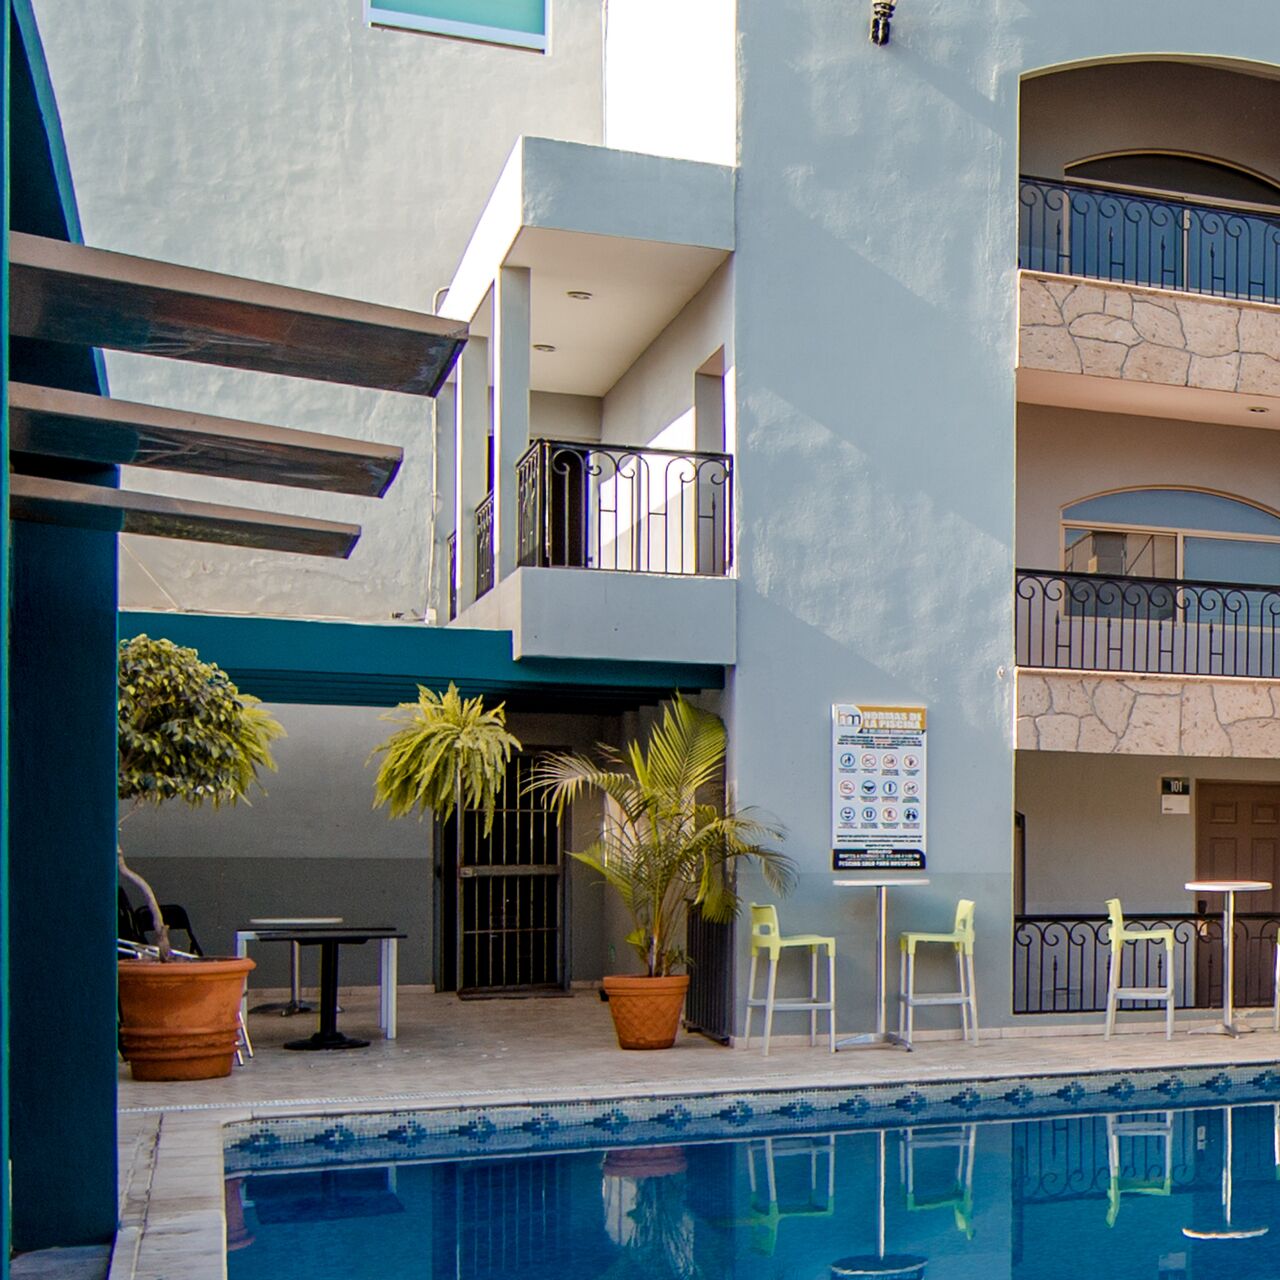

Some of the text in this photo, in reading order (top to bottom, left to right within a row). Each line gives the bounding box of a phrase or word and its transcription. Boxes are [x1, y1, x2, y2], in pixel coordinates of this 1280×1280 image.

[863, 712, 922, 721] NORMAS DE
[864, 720, 921, 729] LA PISCINA
[1170, 780, 1183, 793] 101
